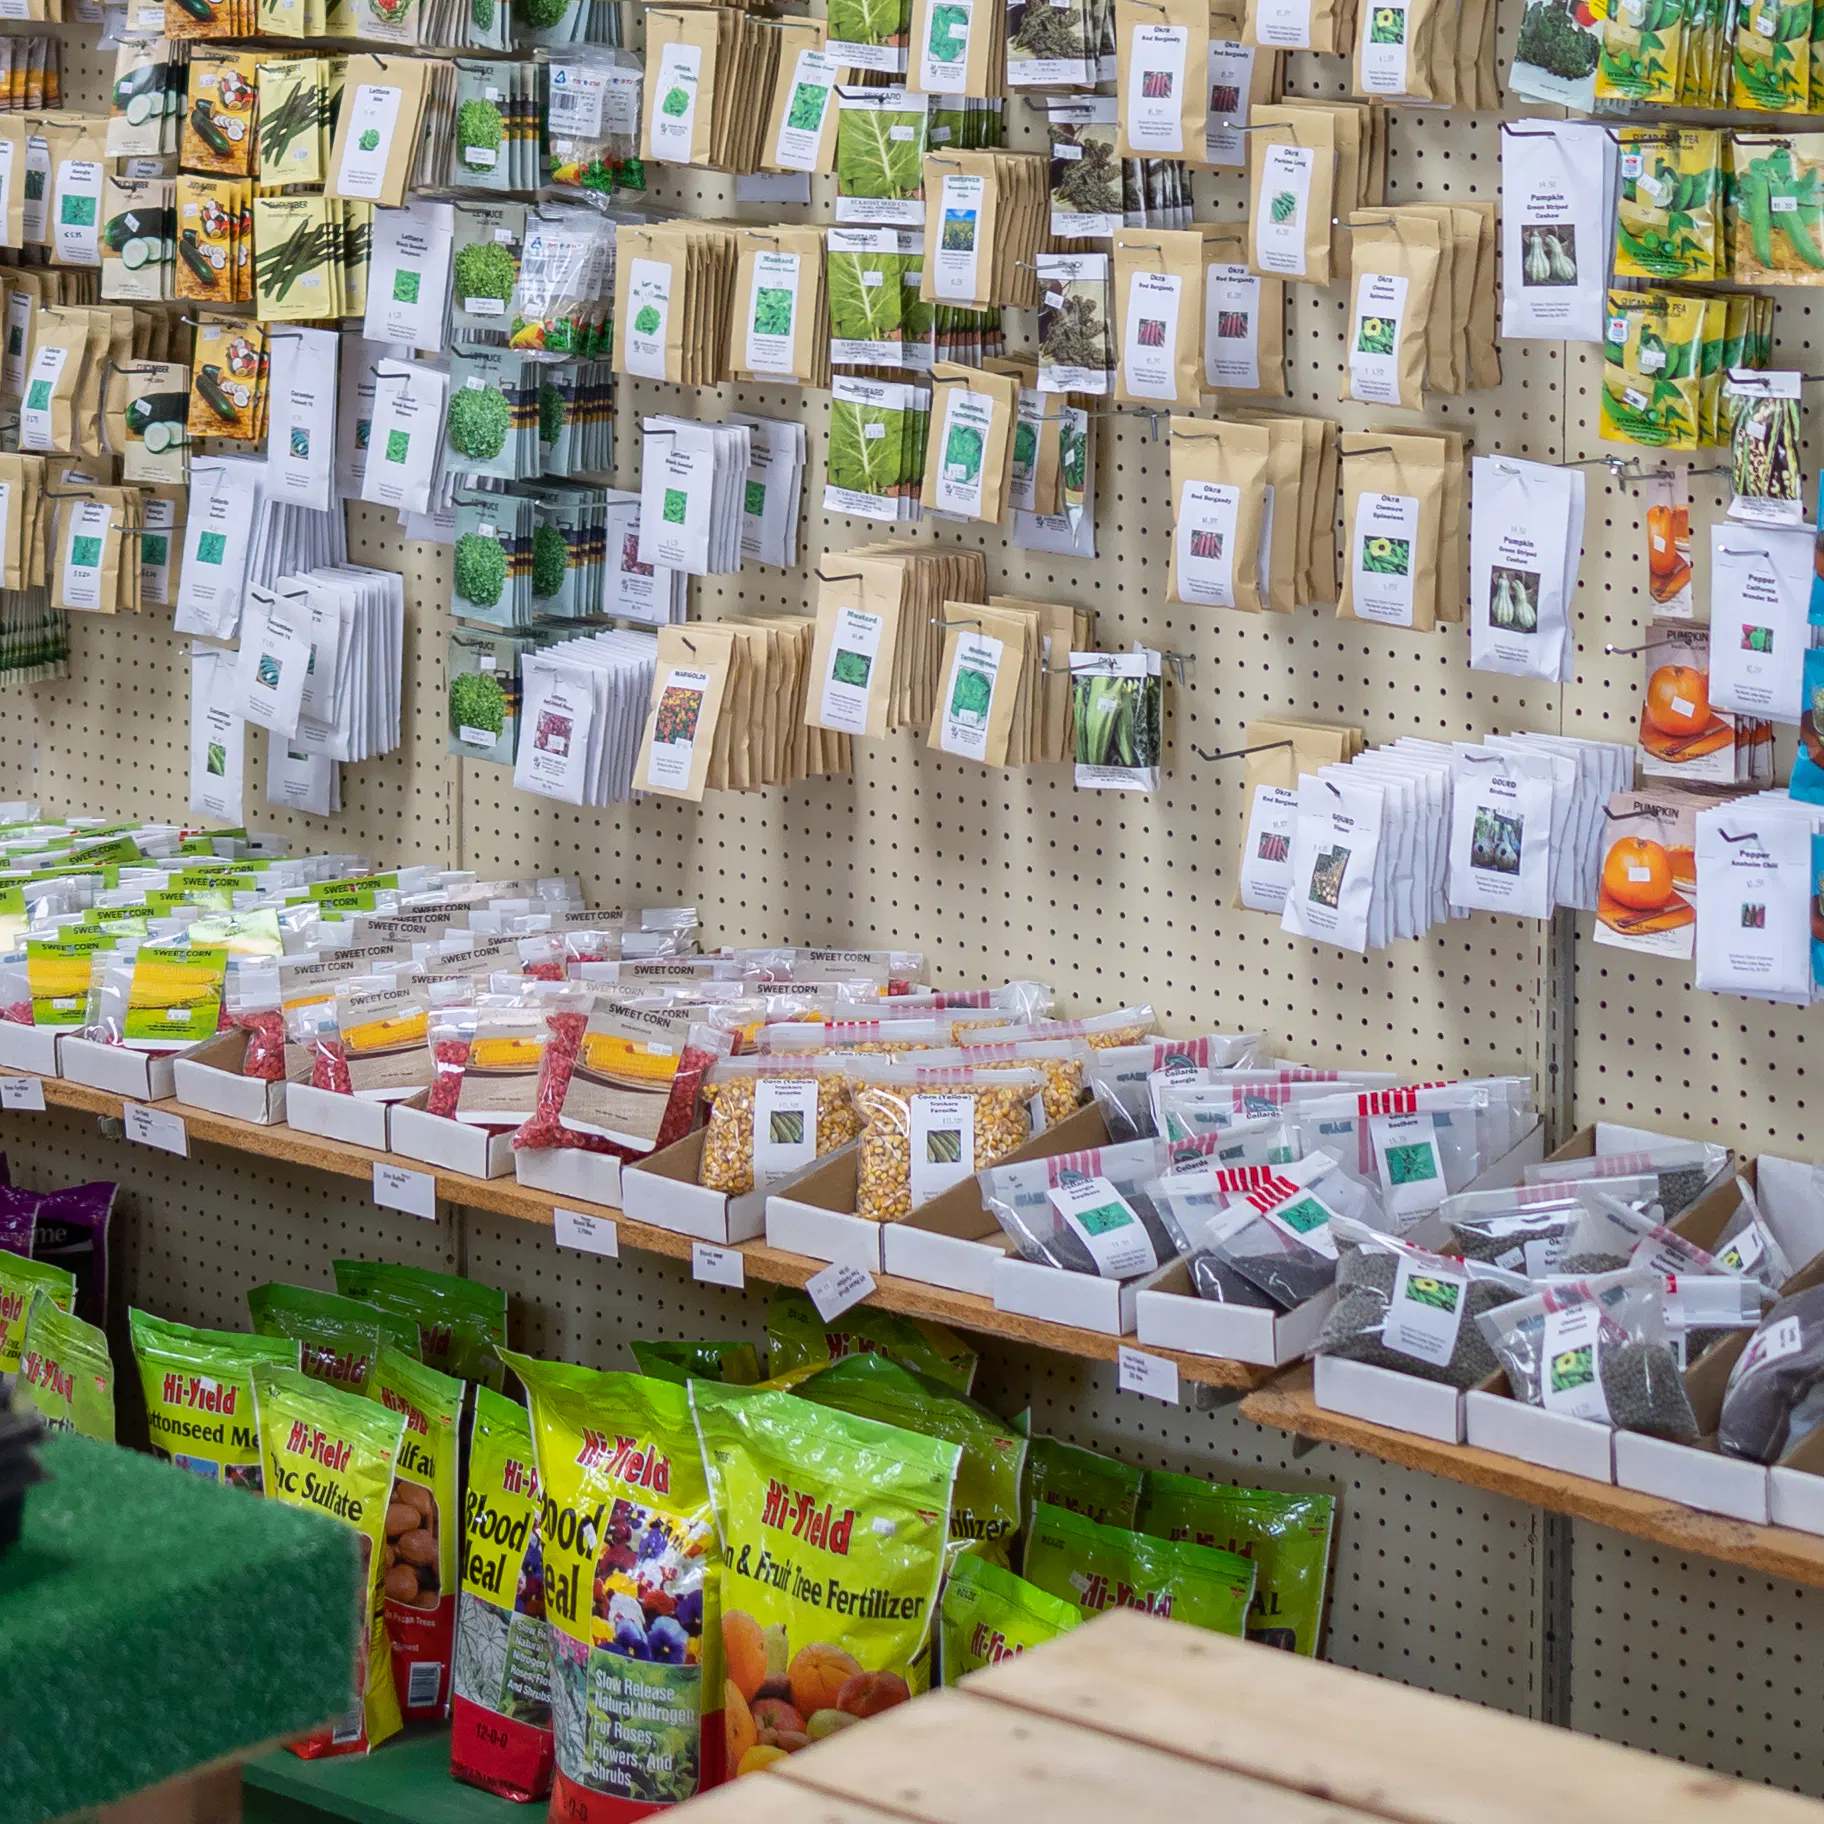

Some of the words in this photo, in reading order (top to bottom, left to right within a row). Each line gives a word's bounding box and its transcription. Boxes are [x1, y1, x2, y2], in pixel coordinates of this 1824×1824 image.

[1153, 25, 1171, 34] Okra
[1530, 192, 1565, 203] Pumpkin
[1526, 203, 1546, 211] Green
[1547, 203, 1569, 212] Striped
[1228, 266, 1245, 275] Okra
[1203, 484, 1222, 494] Okra
[1503, 536, 1535, 549] Pumpkin
[1498, 546, 1518, 556] Green
[1518, 548, 1538, 559] Striped
[1747, 573, 1776, 586] Pepper
[1742, 591, 1765, 602] Wonder
[1746, 583, 1776, 594] California
[1739, 849, 1770, 860] Pepper
[565, 912, 595, 923] SWEET
[596, 910, 623, 921] CORN
[368, 920, 397, 932] SWEET
[399, 922, 427, 934] CORN
[335, 949, 365, 960] SWEET
[366, 945, 394, 956] CORN
[441, 952, 472, 964] SWEET
[473, 946, 500, 958] CORN
[810, 951, 841, 962] SWEET
[843, 952, 872, 963] CORN
[294, 964, 324, 975] SWEET
[326, 961, 354, 972] CORN
[634, 965, 664, 976] SWEET
[665, 965, 695, 976] CORN
[757, 984, 787, 995] SWEET
[789, 984, 819, 995] CORN
[350, 995, 379, 1007] SWEET
[380, 989, 410, 1001] CORN
[608, 1003, 641, 1020] SWEET
[641, 1011, 672, 1028] CORN
[162, 1371, 238, 1417] Hi-Yield
[286, 1419, 354, 1474] Hi-Yield
[576, 1425, 672, 1497] Hi-Yield
[301, 1471, 364, 1522] Sulfate
[465, 1490, 531, 1555] Blood
[761, 1478, 857, 1557] Hi-Yield
[736, 1544, 751, 1579] &
[753, 1550, 793, 1596] Fruit
[792, 1566, 823, 1606] Tree
[825, 1580, 925, 1621] Fertilizer
[514, 1633, 544, 1654] Natural
[507, 1678, 526, 1695] And
[595, 1667, 622, 1691] Slow
[623, 1675, 676, 1702] Release
[594, 1692, 634, 1716] Natural
[637, 1701, 695, 1726] Nitrogen
[474, 1722, 509, 1749] 12-0-0
[592, 1718, 611, 1738] For
[612, 1721, 658, 1746] Roses,
[592, 1740, 645, 1769] Flowers,
[647, 1752, 674, 1772] And
[591, 1760, 633, 1788] Shrubs
